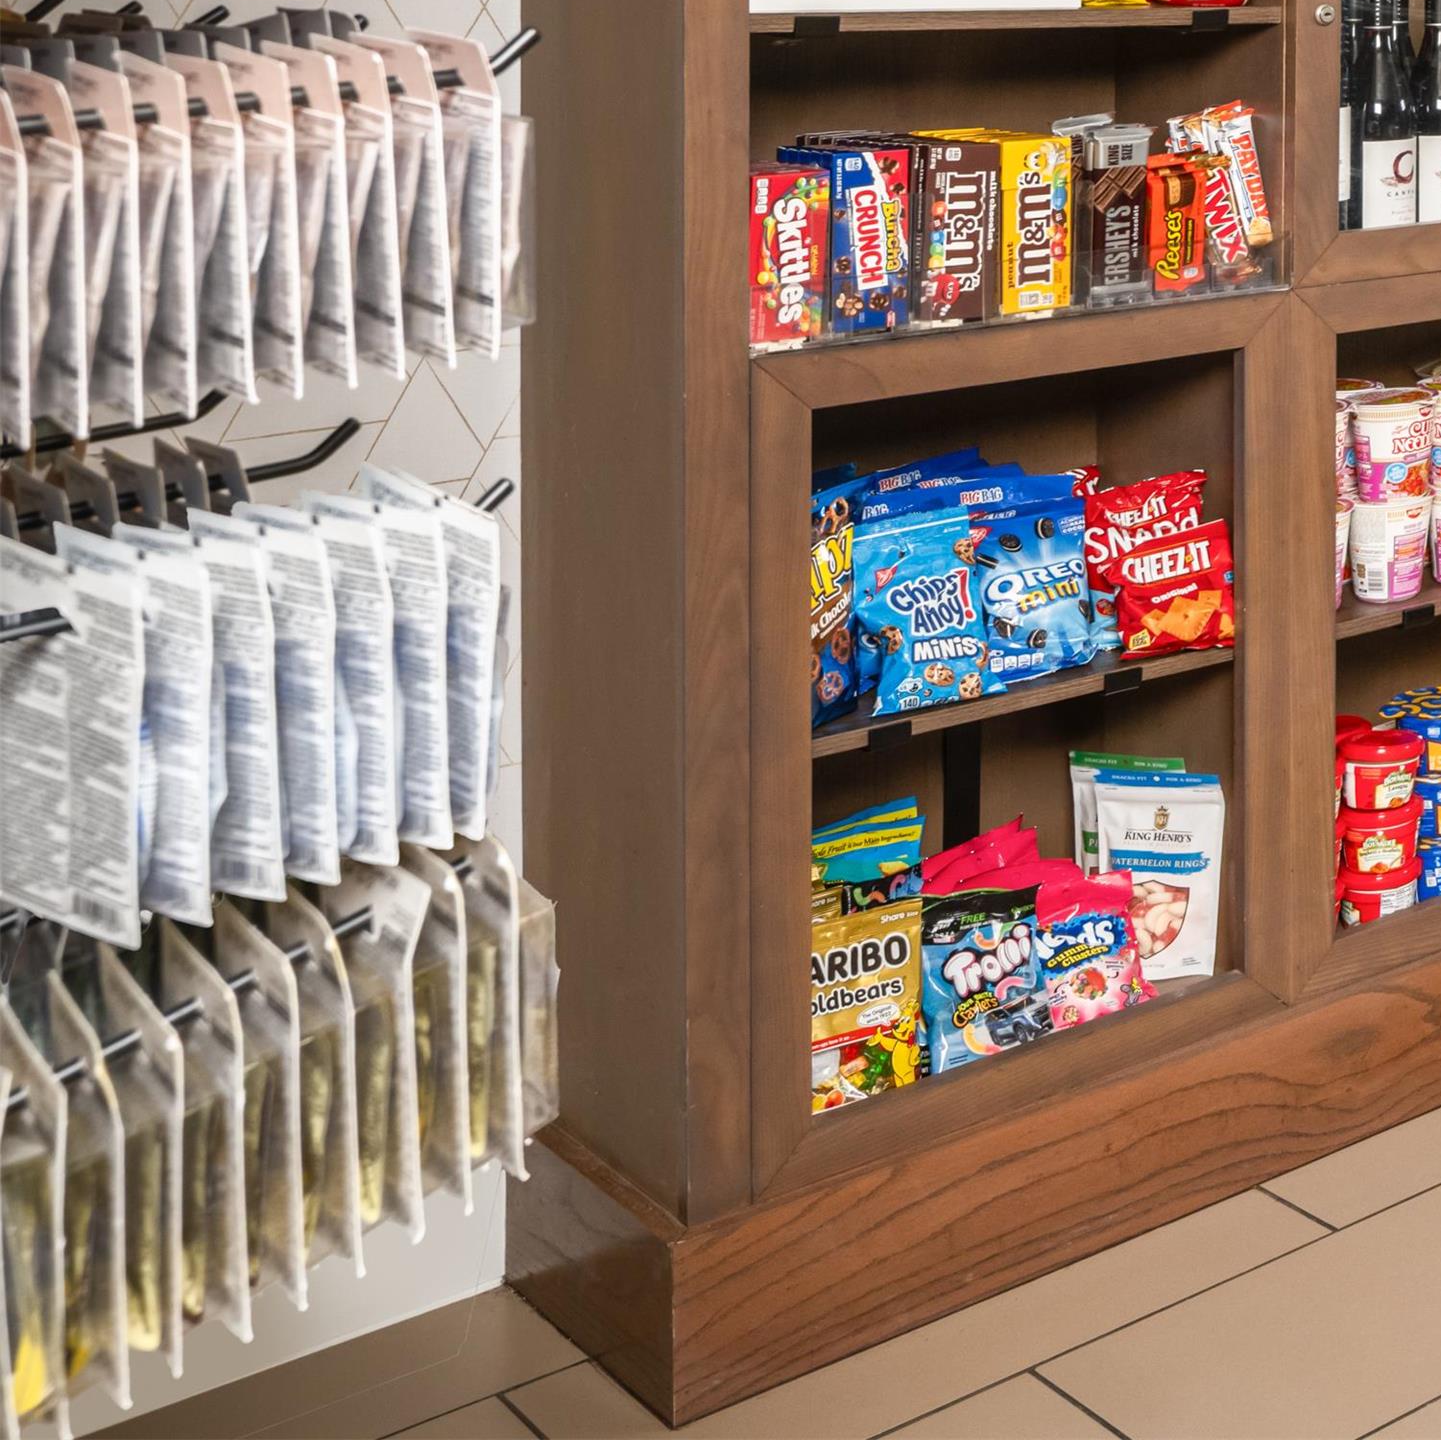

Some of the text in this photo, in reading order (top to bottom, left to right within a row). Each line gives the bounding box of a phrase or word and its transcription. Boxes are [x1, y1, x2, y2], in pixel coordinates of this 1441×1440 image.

[1108, 144, 1119, 166] KING
[1122, 144, 1133, 160] SIZE
[1017, 172, 1051, 288] m&m's
[1205, 168, 1248, 263] TWIX
[854, 189, 884, 284] CRUNCH
[881, 198, 903, 272] Buncha
[1157, 211, 1182, 279] Reese's
[774, 198, 810, 323] Skittles
[879, 477, 899, 491] BIG
[960, 487, 1002, 504] BIG BAG
[888, 573, 959, 613] Chips
[988, 559, 1085, 604] OREO
[1019, 578, 1079, 613] mini
[1125, 831, 1193, 843] KING HENRY'S
[1175, 859, 1206, 868] RINGS
[881, 912, 905, 923] Share
[960, 913, 985, 924] FREE
[812, 932, 908, 986] ARIBO
[945, 925, 1031, 997] Trolli
[953, 997, 998, 1028] Crawlers
